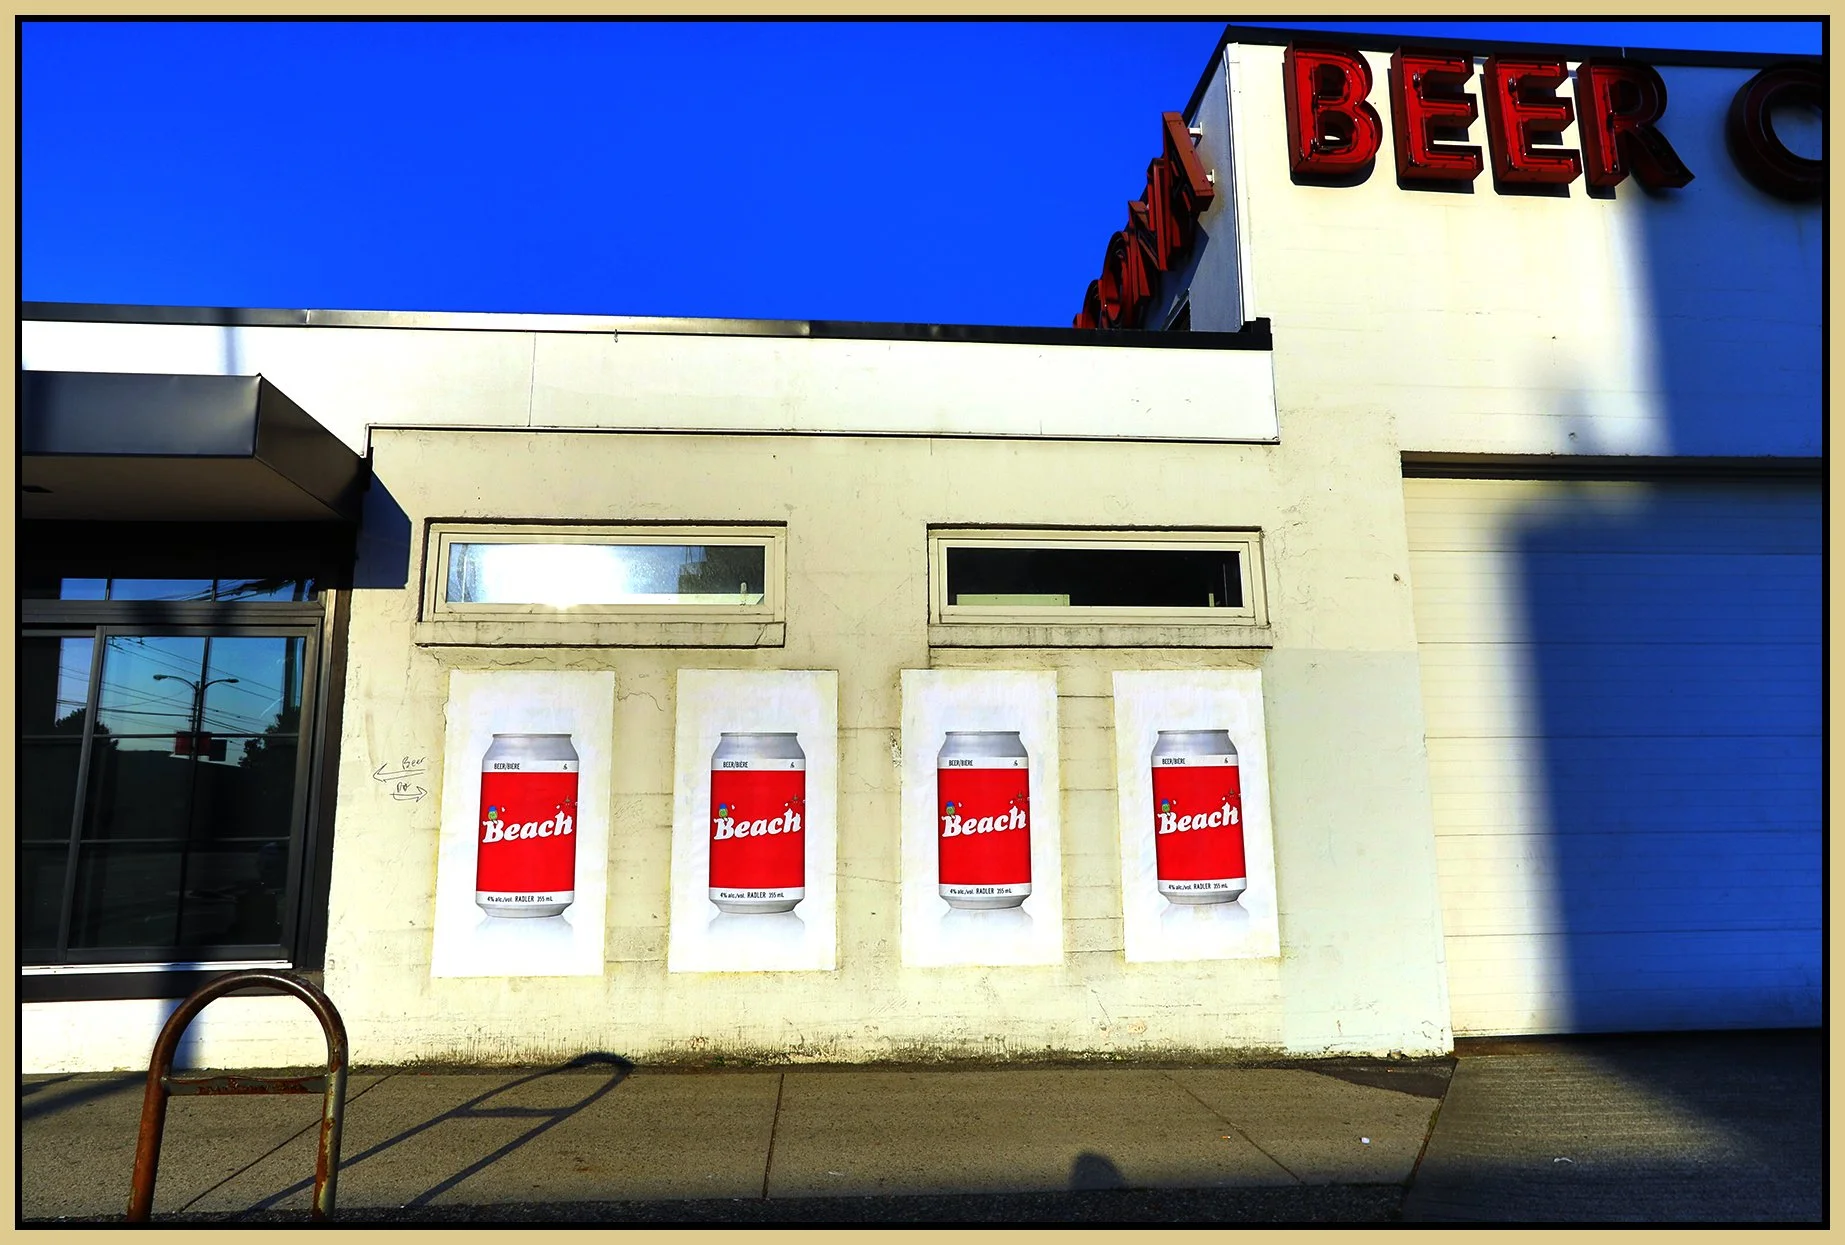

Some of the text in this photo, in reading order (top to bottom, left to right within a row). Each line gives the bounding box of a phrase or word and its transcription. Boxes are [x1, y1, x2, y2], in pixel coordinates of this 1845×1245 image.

[1283, 39, 1695, 190] BEER
[401, 756, 426, 770] Beer
[482, 810, 573, 843] Beach
[713, 808, 802, 841] Beach
[941, 805, 1027, 838] Beach
[1156, 802, 1239, 835] Beach
[1193, 882, 1212, 890] RADLER
